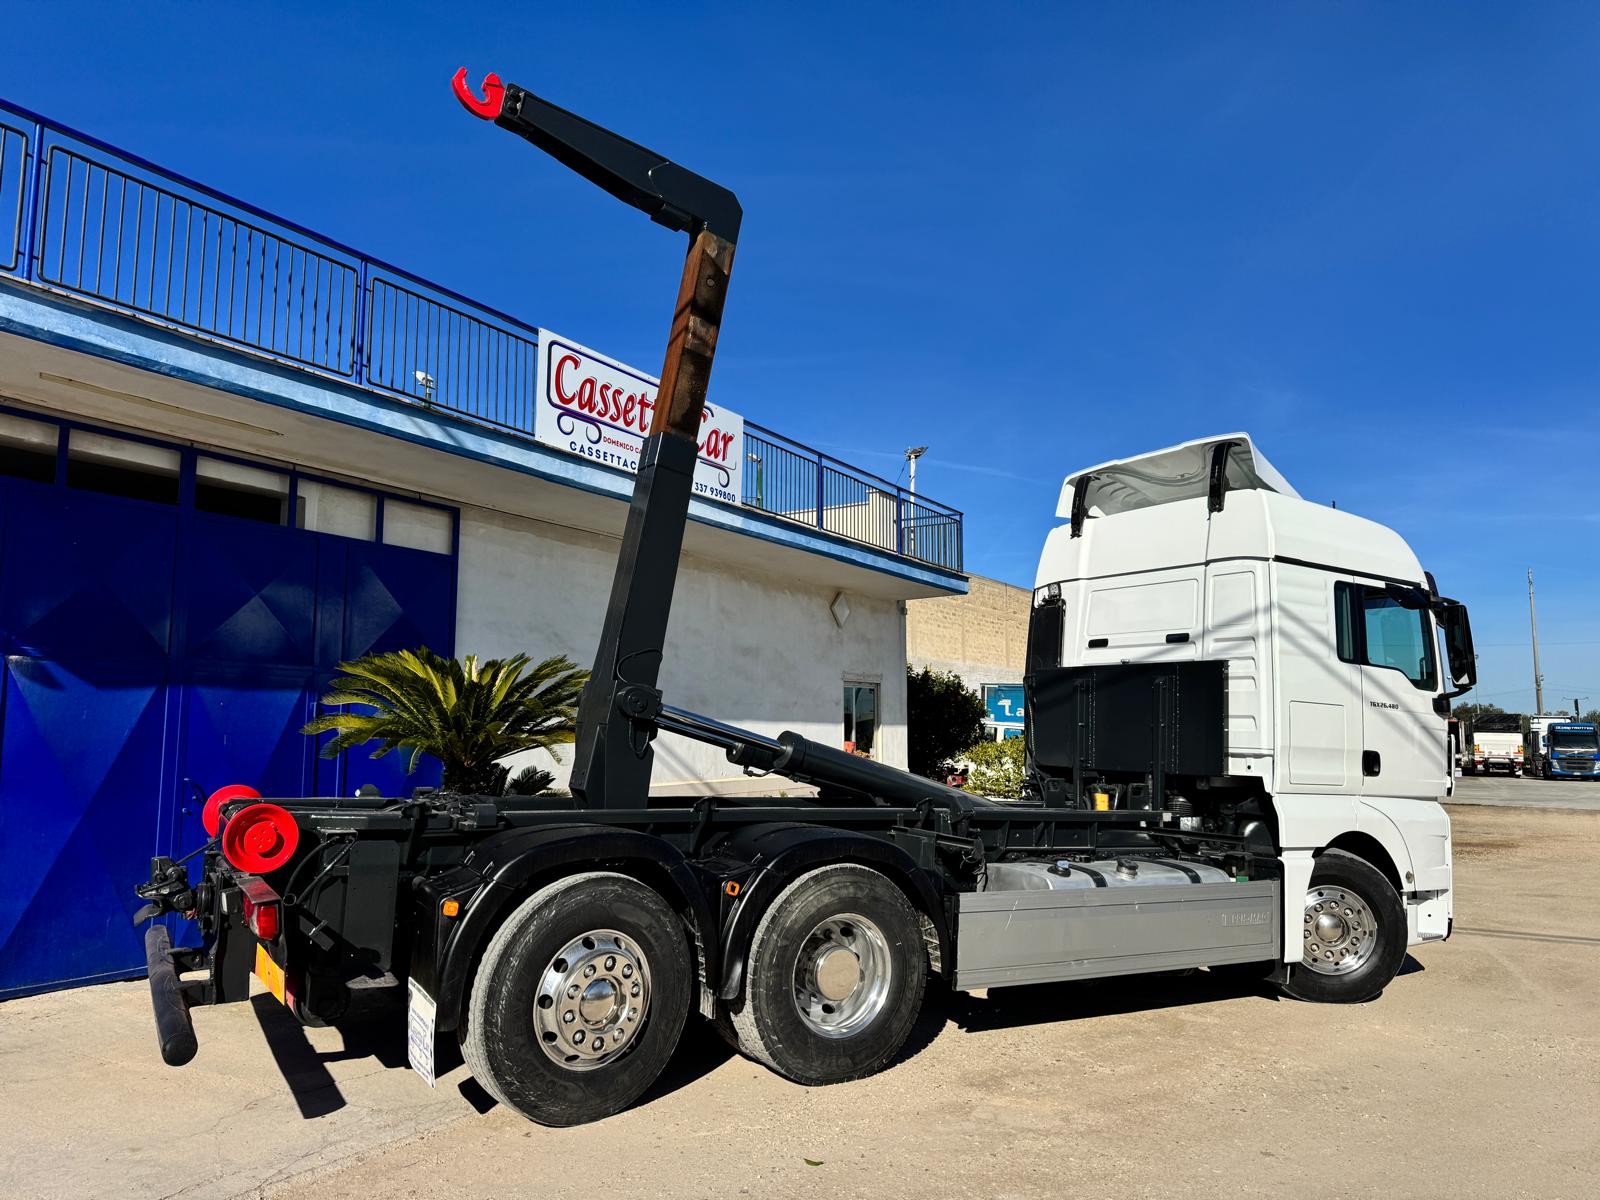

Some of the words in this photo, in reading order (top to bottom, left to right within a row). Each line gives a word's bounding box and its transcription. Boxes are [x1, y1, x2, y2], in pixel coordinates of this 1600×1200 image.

[555, 354, 657, 433] Casset
[602, 435, 634, 452] DOMENICO
[694, 482, 708, 494] 337
[709, 487, 736, 502] 939800
